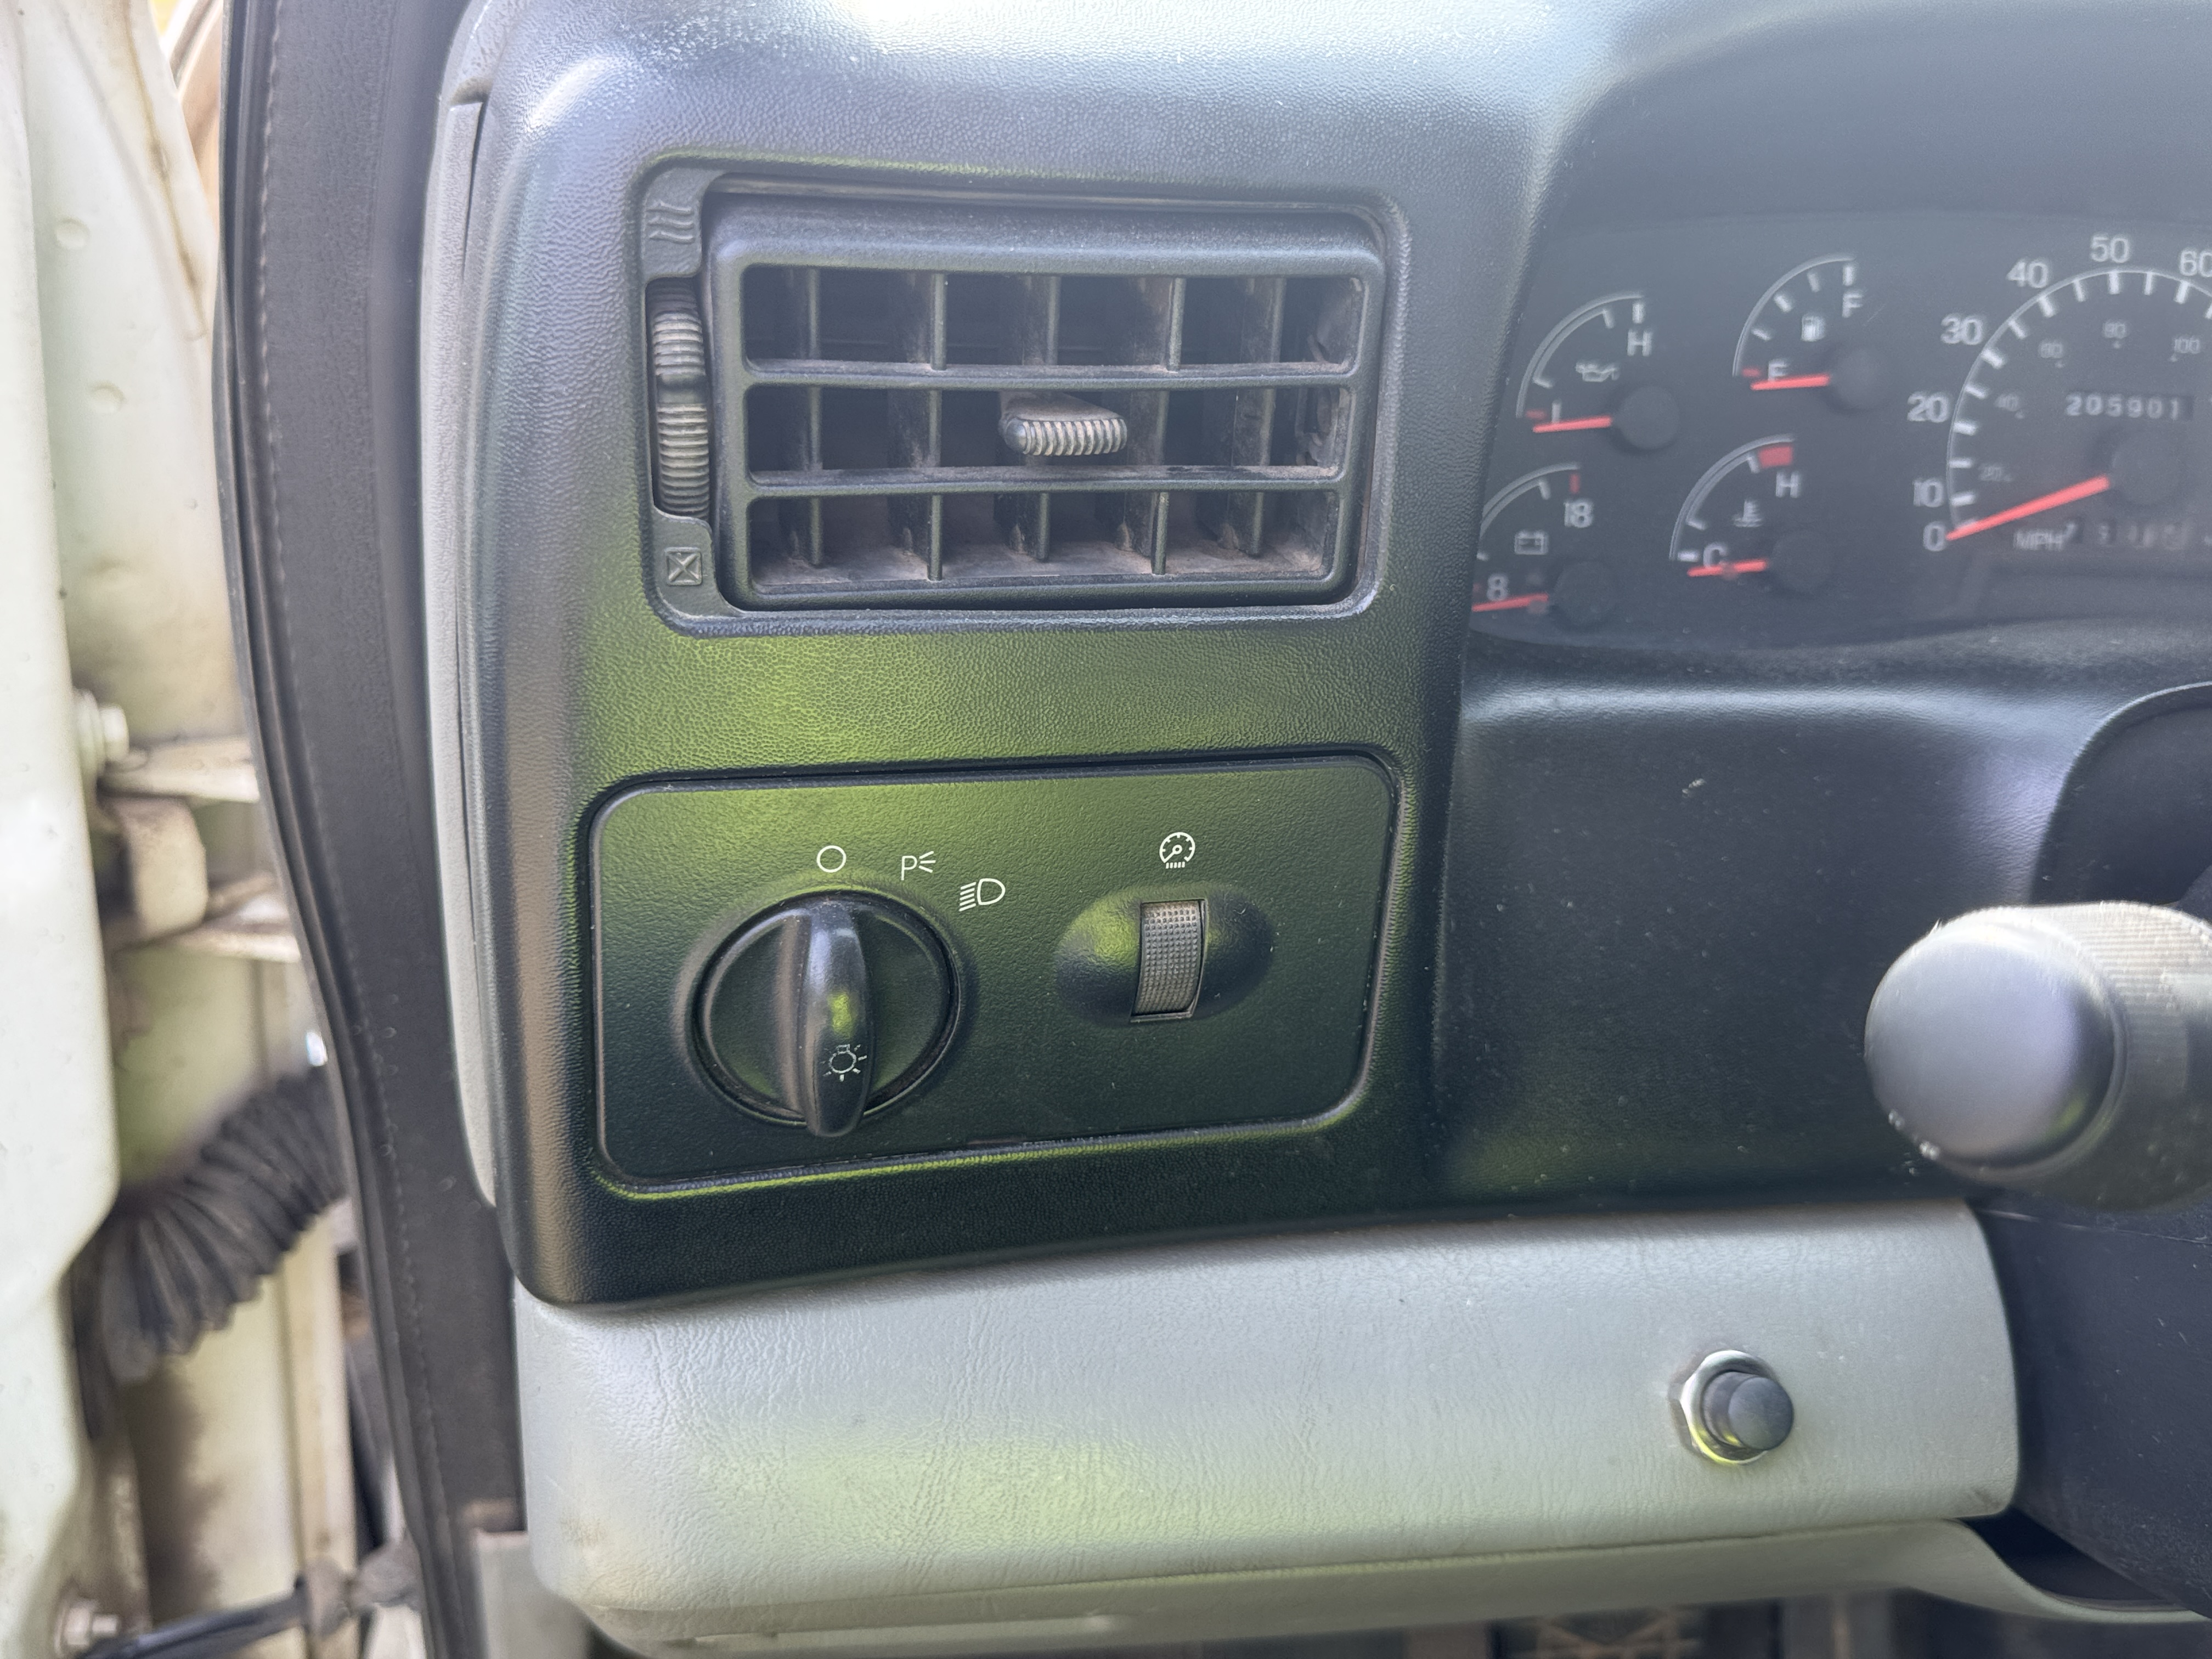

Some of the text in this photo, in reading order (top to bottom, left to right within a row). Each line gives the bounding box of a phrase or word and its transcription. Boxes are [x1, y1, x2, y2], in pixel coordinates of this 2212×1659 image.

[2090, 234, 2130, 263] 50
[2007, 259, 2050, 289] 40
[2179, 249, 2212, 278] 60
[1842, 291, 1863, 318] F
[1627, 329, 1652, 356] H
[1940, 314, 1984, 345] 30
[1768, 359, 1788, 382] E
[1906, 392, 1949, 424] 20
[2066, 393, 2180, 420] 205901
[1775, 472, 1802, 498] H
[1913, 477, 1945, 508] 10
[1564, 499, 1593, 528] 18
[1922, 522, 1948, 552] 0
[1703, 542, 1729, 569] C
[1487, 573, 1509, 602] 8
